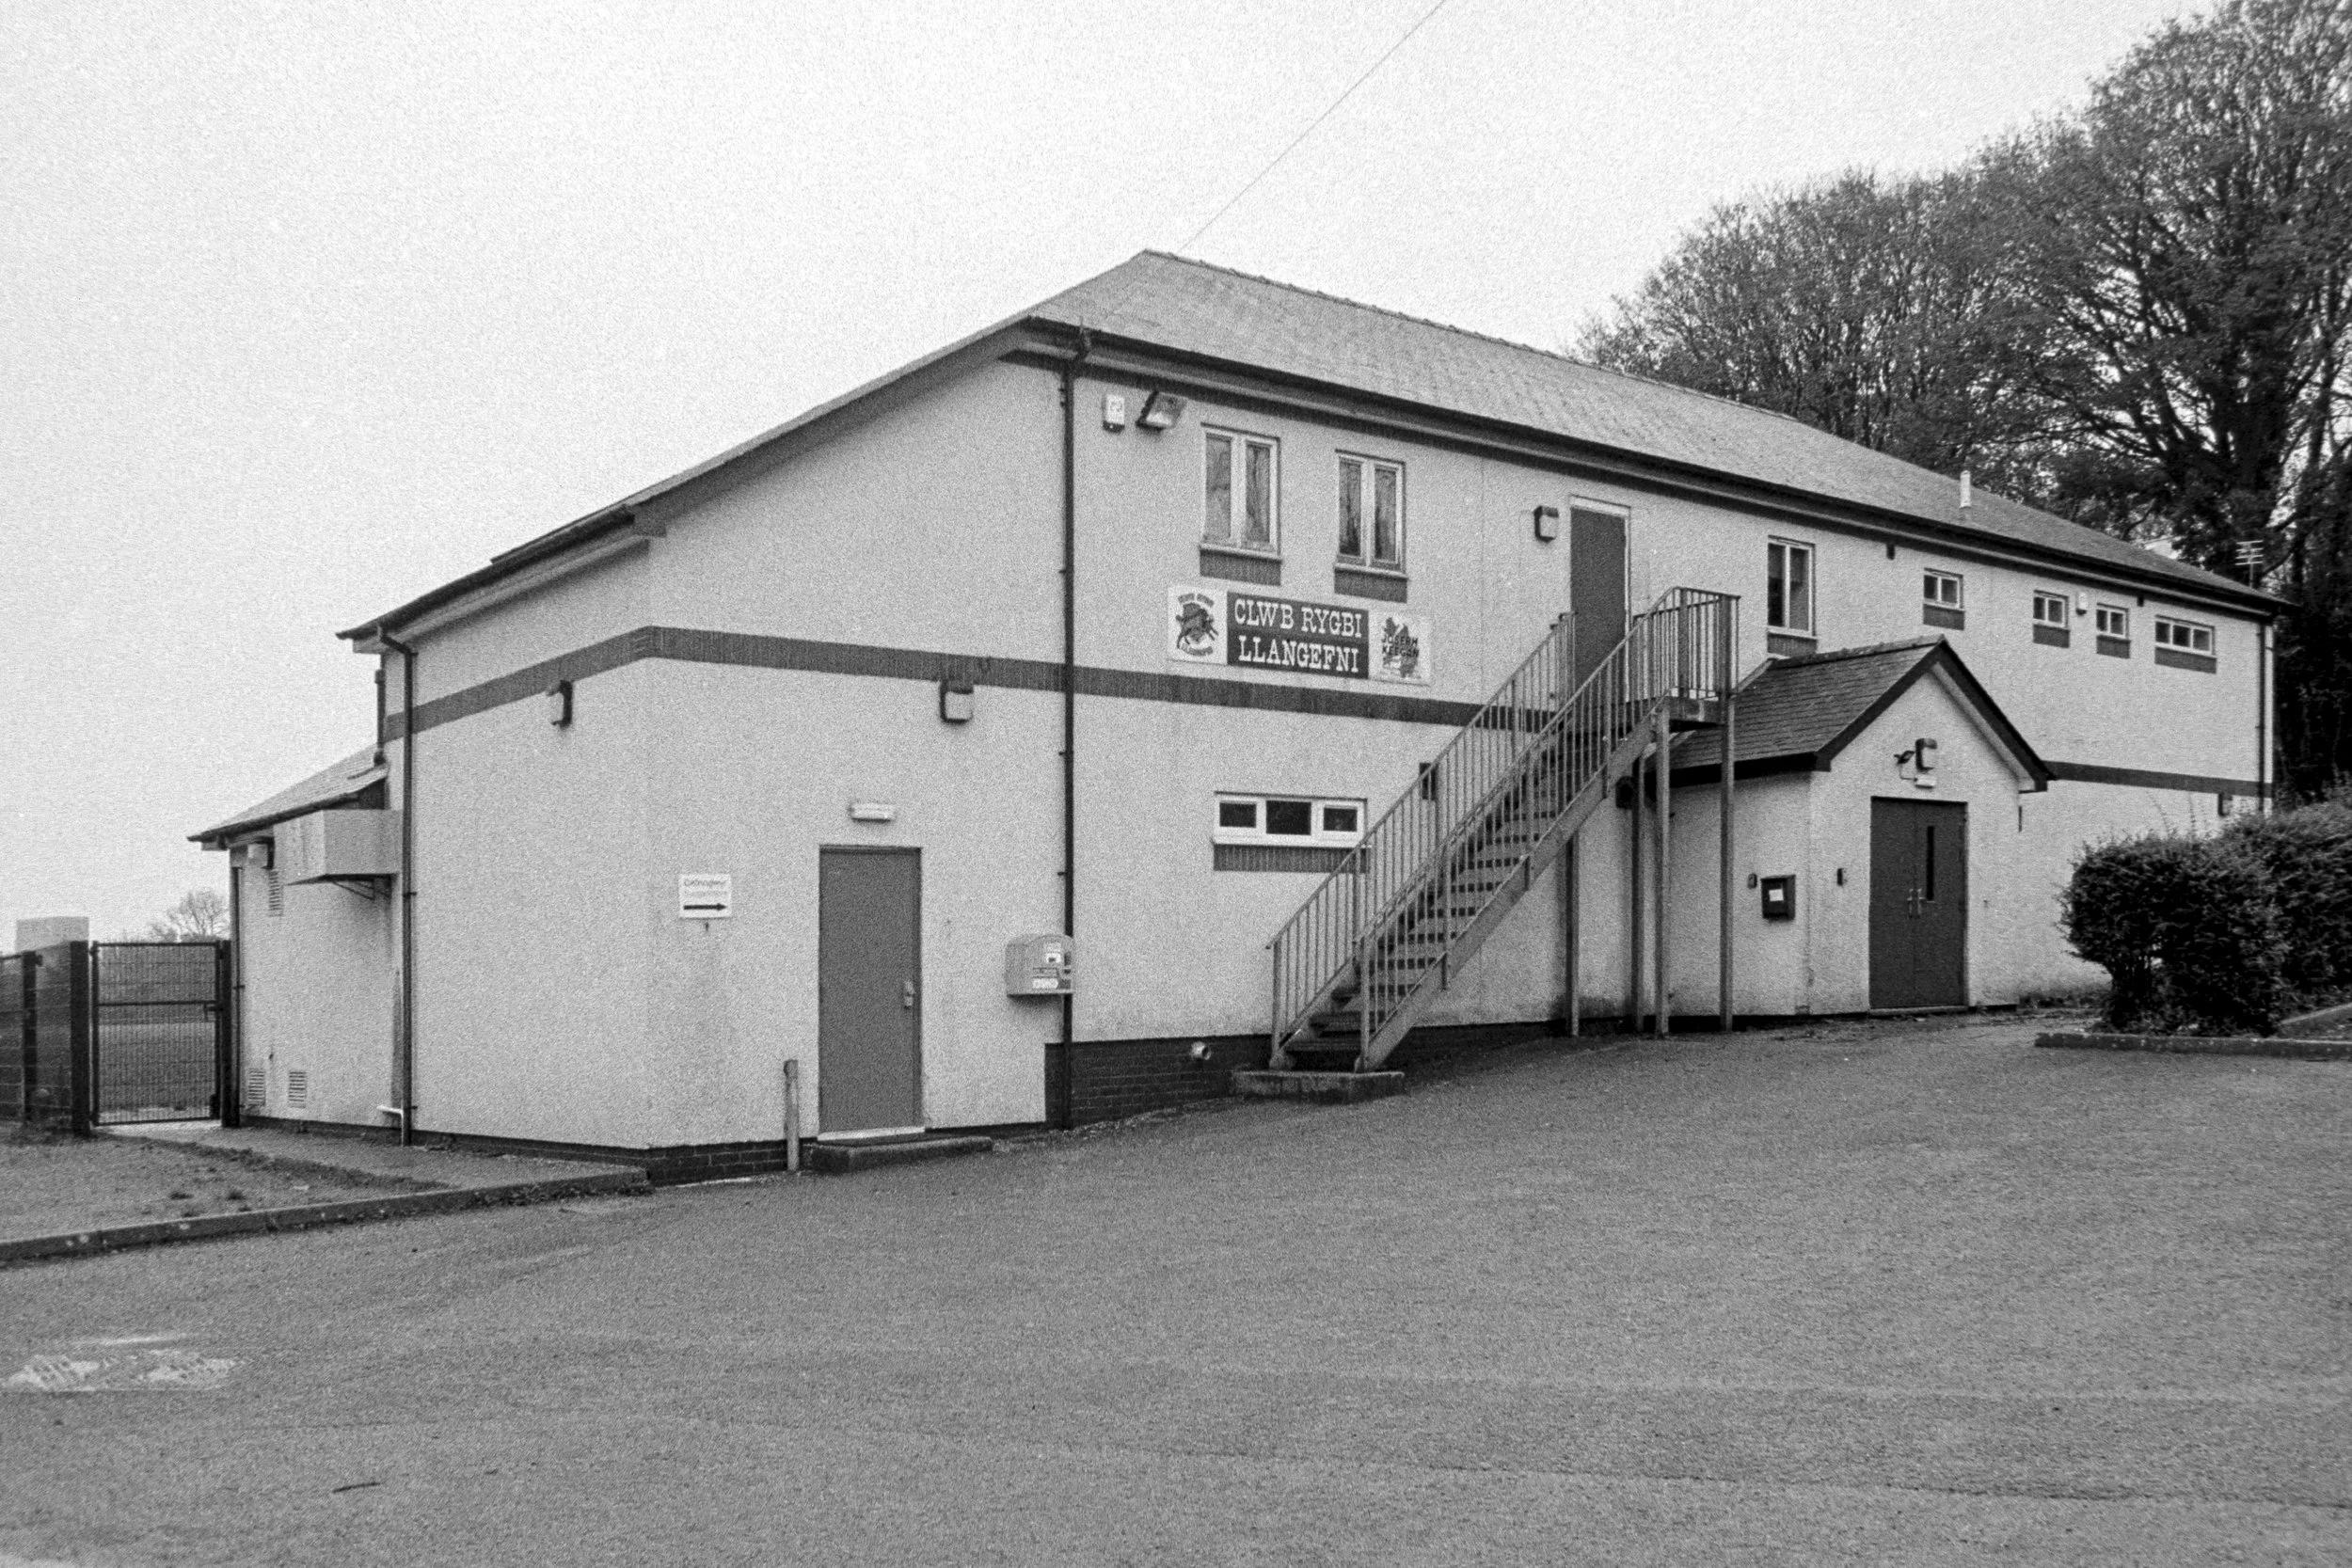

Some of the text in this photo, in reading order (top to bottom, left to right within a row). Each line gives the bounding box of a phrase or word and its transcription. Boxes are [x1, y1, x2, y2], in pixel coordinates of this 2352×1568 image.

[1234, 598, 1295, 629] CLWB
[1300, 606, 1362, 639] RYGBI
[1238, 634, 1359, 673] LLANGEFNI
